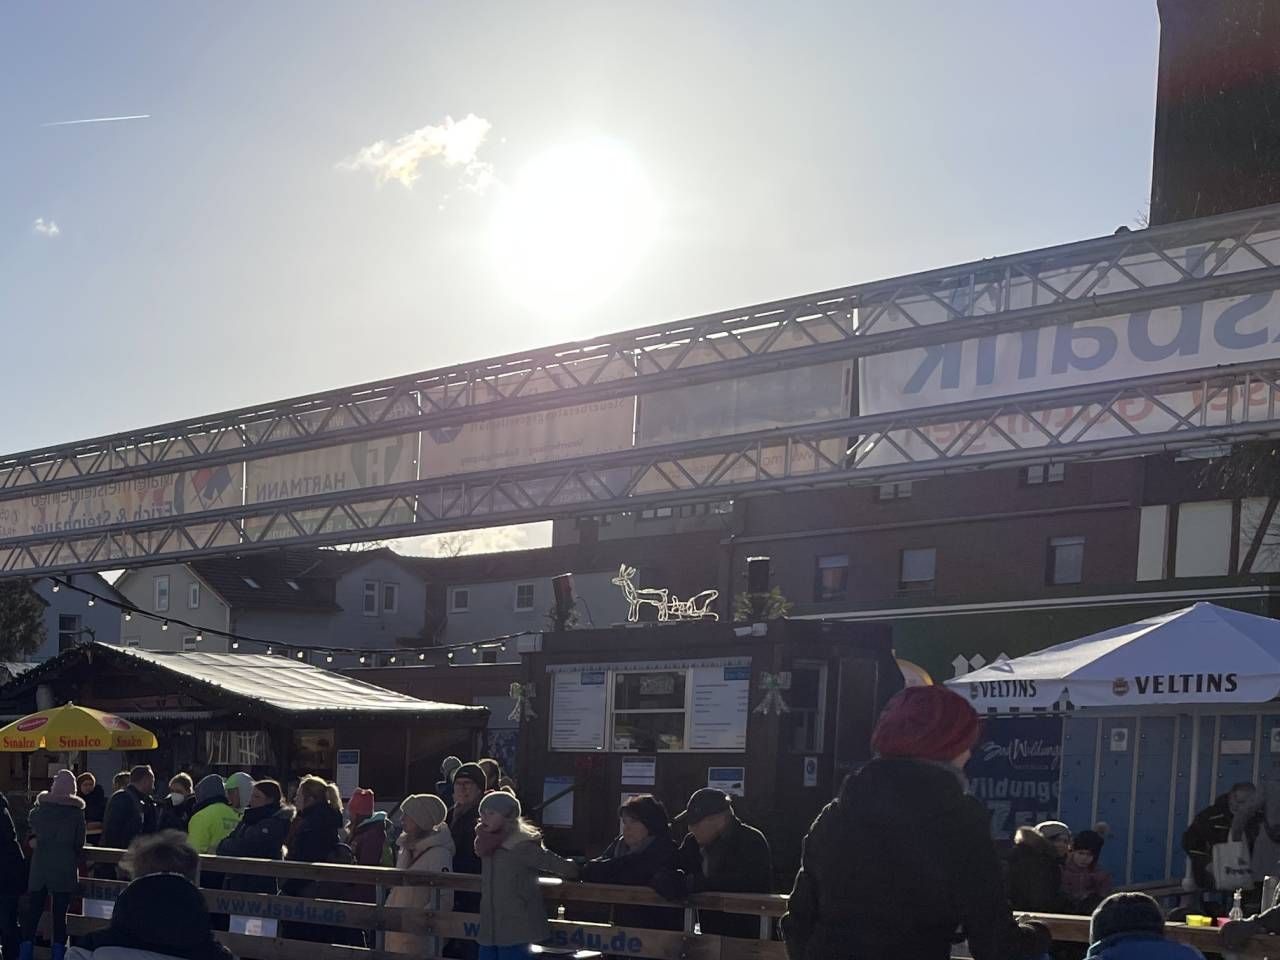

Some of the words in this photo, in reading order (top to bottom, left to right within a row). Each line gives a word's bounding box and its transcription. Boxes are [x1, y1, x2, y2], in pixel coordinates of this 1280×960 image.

[980, 680, 1037, 699] VELTINS
[1135, 673, 1238, 694] VELTINS
[3, 736, 36, 748] Sinalco
[59, 735, 102, 748] Sinalco
[219, 896, 347, 923] www.iss4u.de
